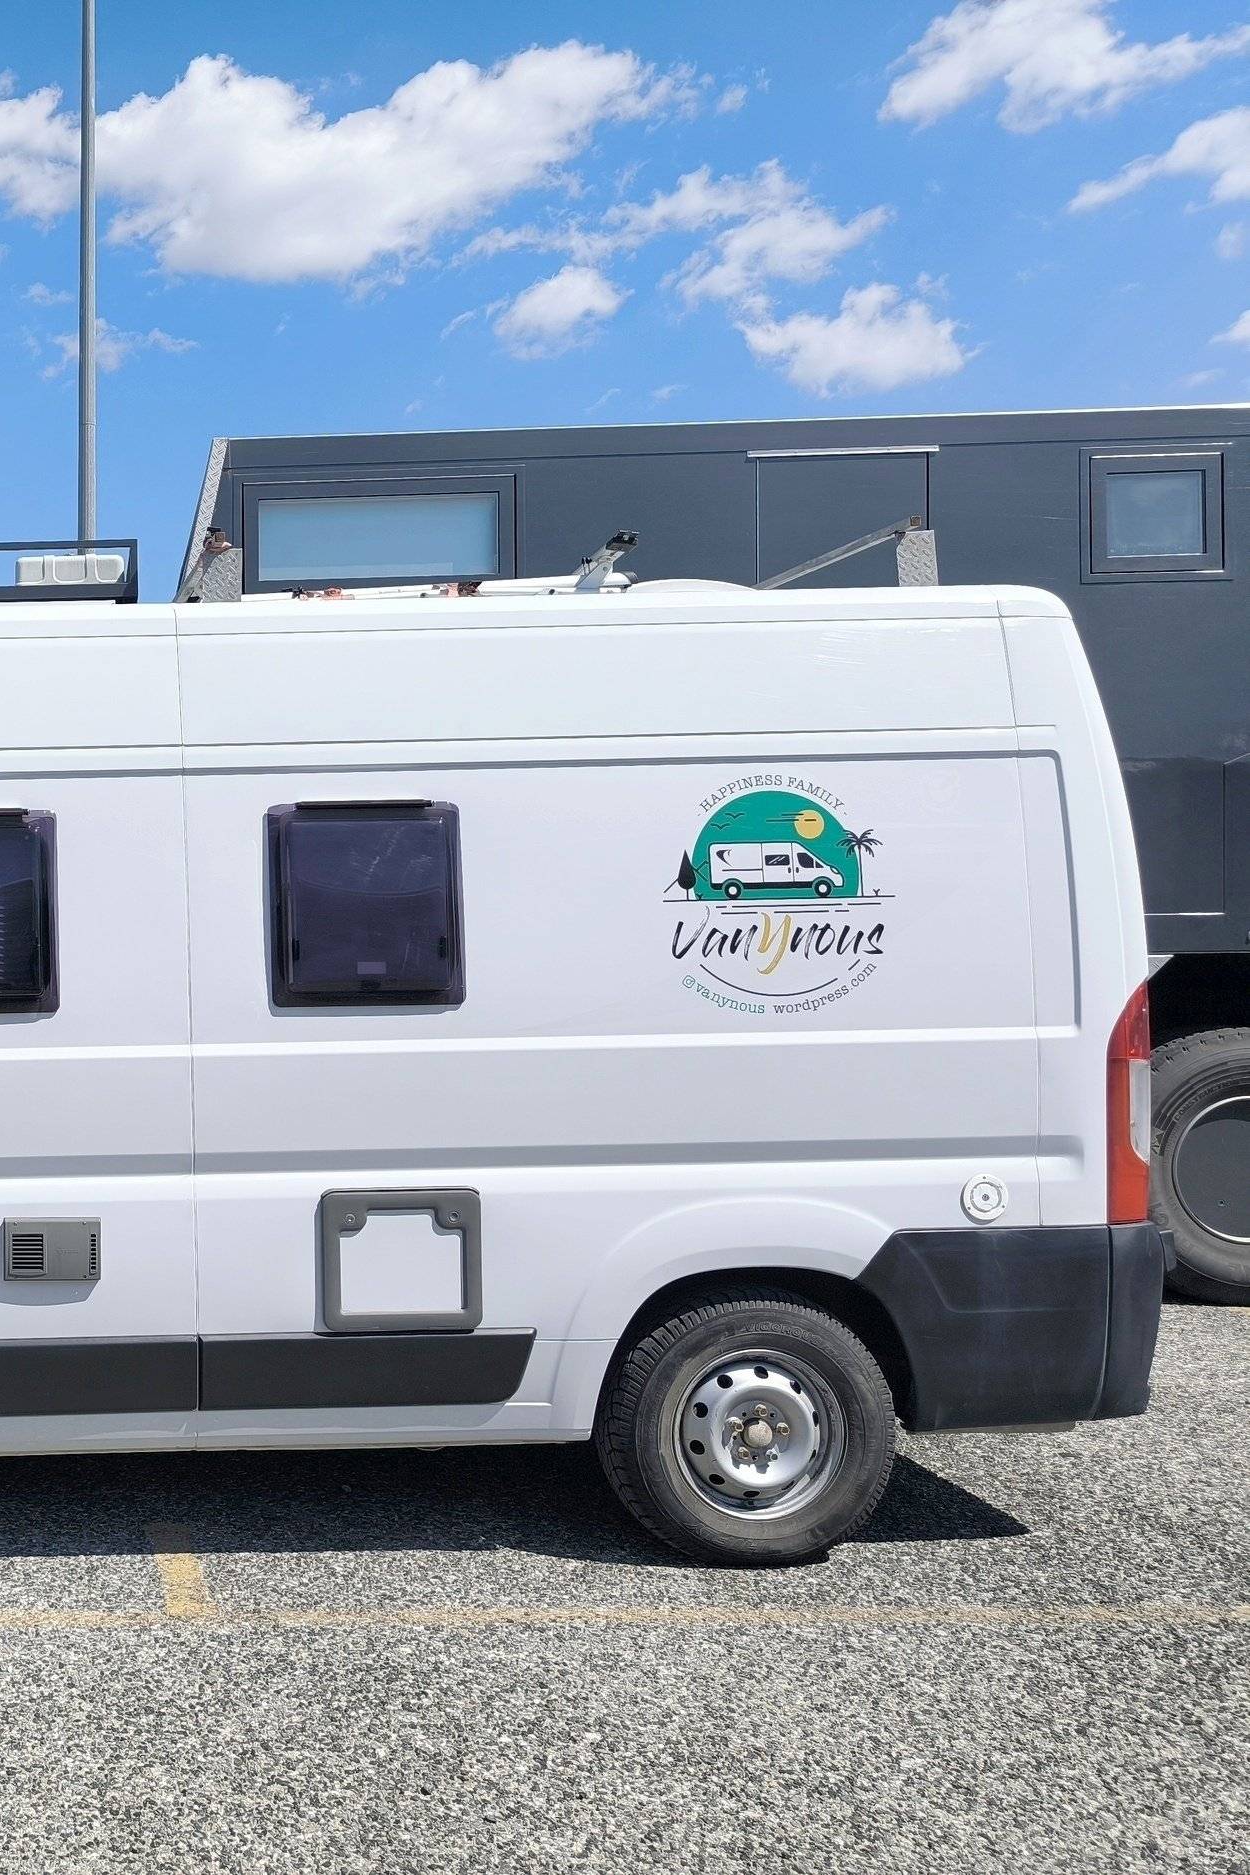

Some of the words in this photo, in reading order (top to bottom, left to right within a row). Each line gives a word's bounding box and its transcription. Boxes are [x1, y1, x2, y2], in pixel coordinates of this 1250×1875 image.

[699, 774, 784, 813] HAPPINESS
[787, 776, 846, 811] FAMILY
[772, 962, 877, 1015] wordpress.com
